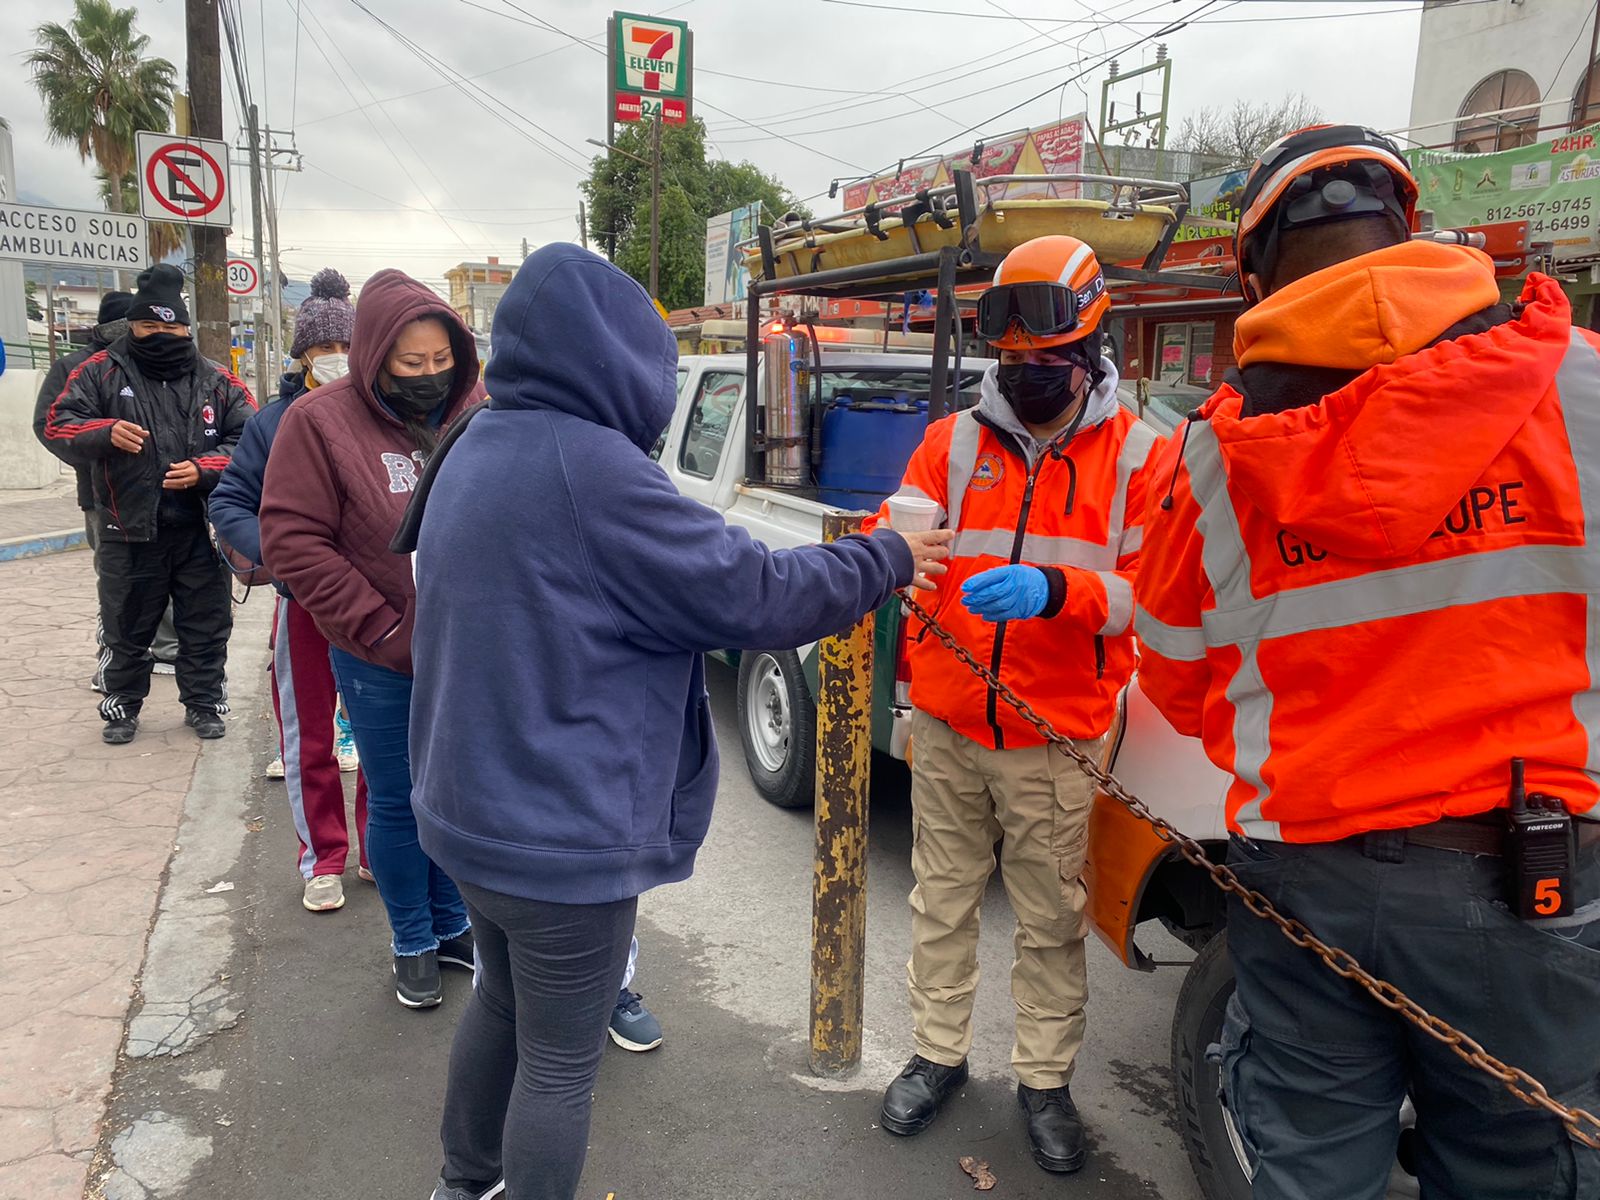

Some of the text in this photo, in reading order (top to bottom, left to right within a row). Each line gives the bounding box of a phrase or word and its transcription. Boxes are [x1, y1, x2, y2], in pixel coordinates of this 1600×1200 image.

[1487, 197, 1592, 221] 812-567-9745
[0, 210, 137, 239] ACCESO SOLO
[1531, 215, 1590, 232] 4-6499
[0, 235, 139, 263] AMBULANCIAS
[229, 266, 248, 282] 30
[204, 428, 219, 438] OP
[1526, 823, 1564, 832] FORTECOM
[1534, 877, 1562, 915] 5
